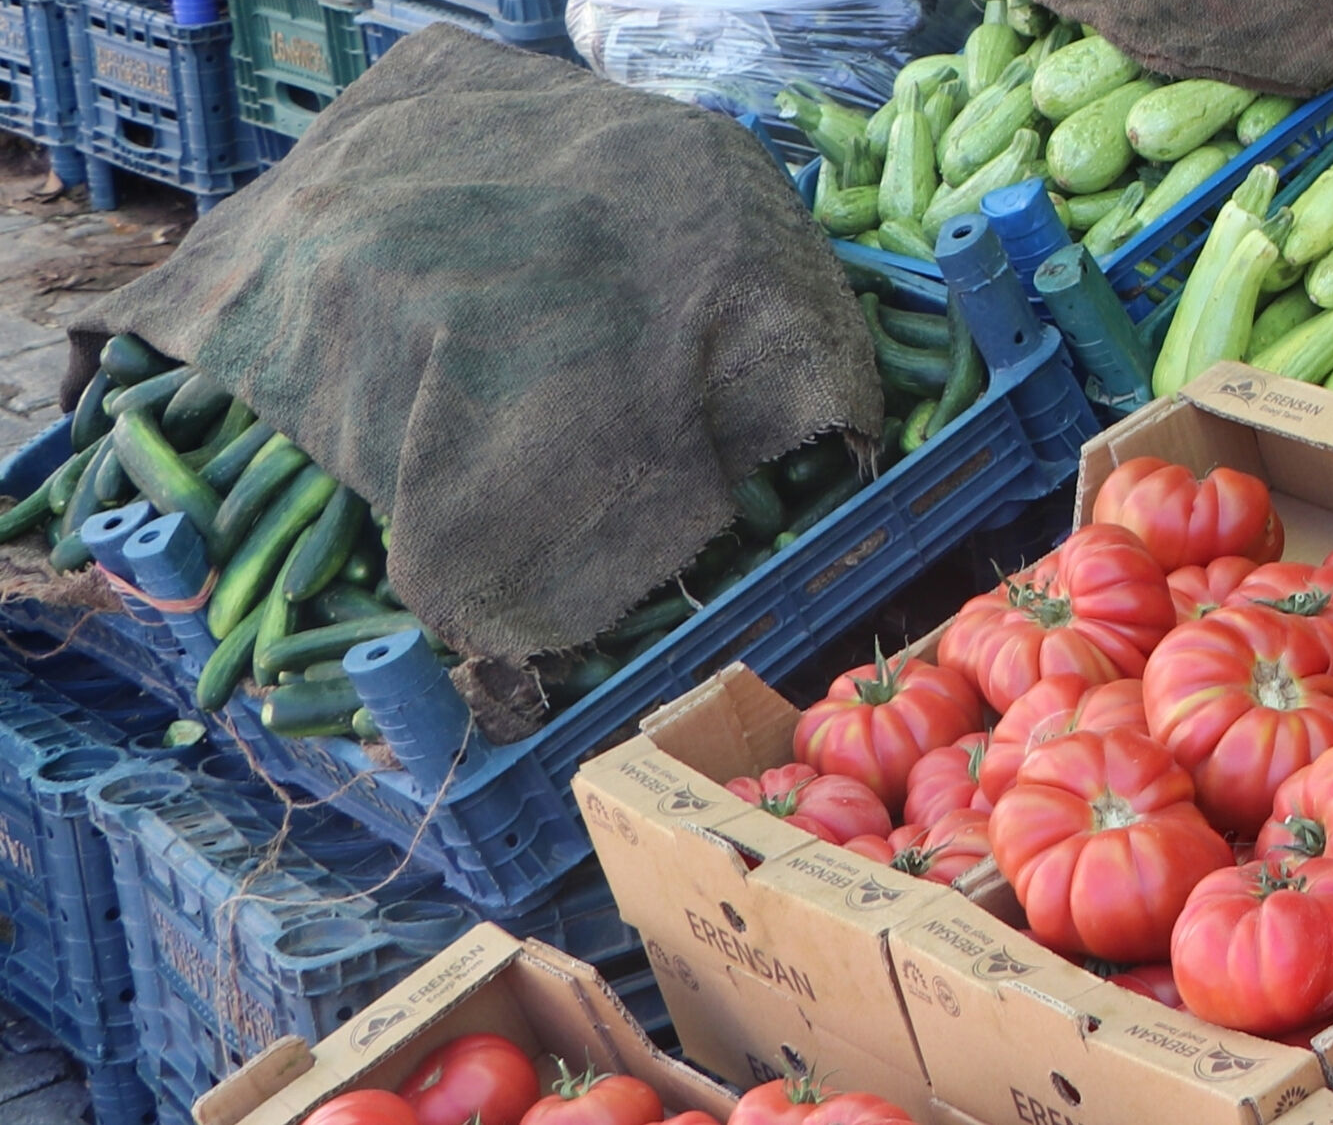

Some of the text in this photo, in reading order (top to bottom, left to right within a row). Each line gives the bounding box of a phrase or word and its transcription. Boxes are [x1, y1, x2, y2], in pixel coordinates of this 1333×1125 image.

[1261, 389, 1325, 417] ERENSAN
[619, 762, 670, 795] ERENSAN
[787, 857, 853, 891] ERENSAN
[685, 907, 818, 1004] ERENSAN
[922, 919, 985, 959] ERENSAN
[407, 944, 486, 1004] ERENSAN
[1125, 1024, 1201, 1059] ERENSAN
